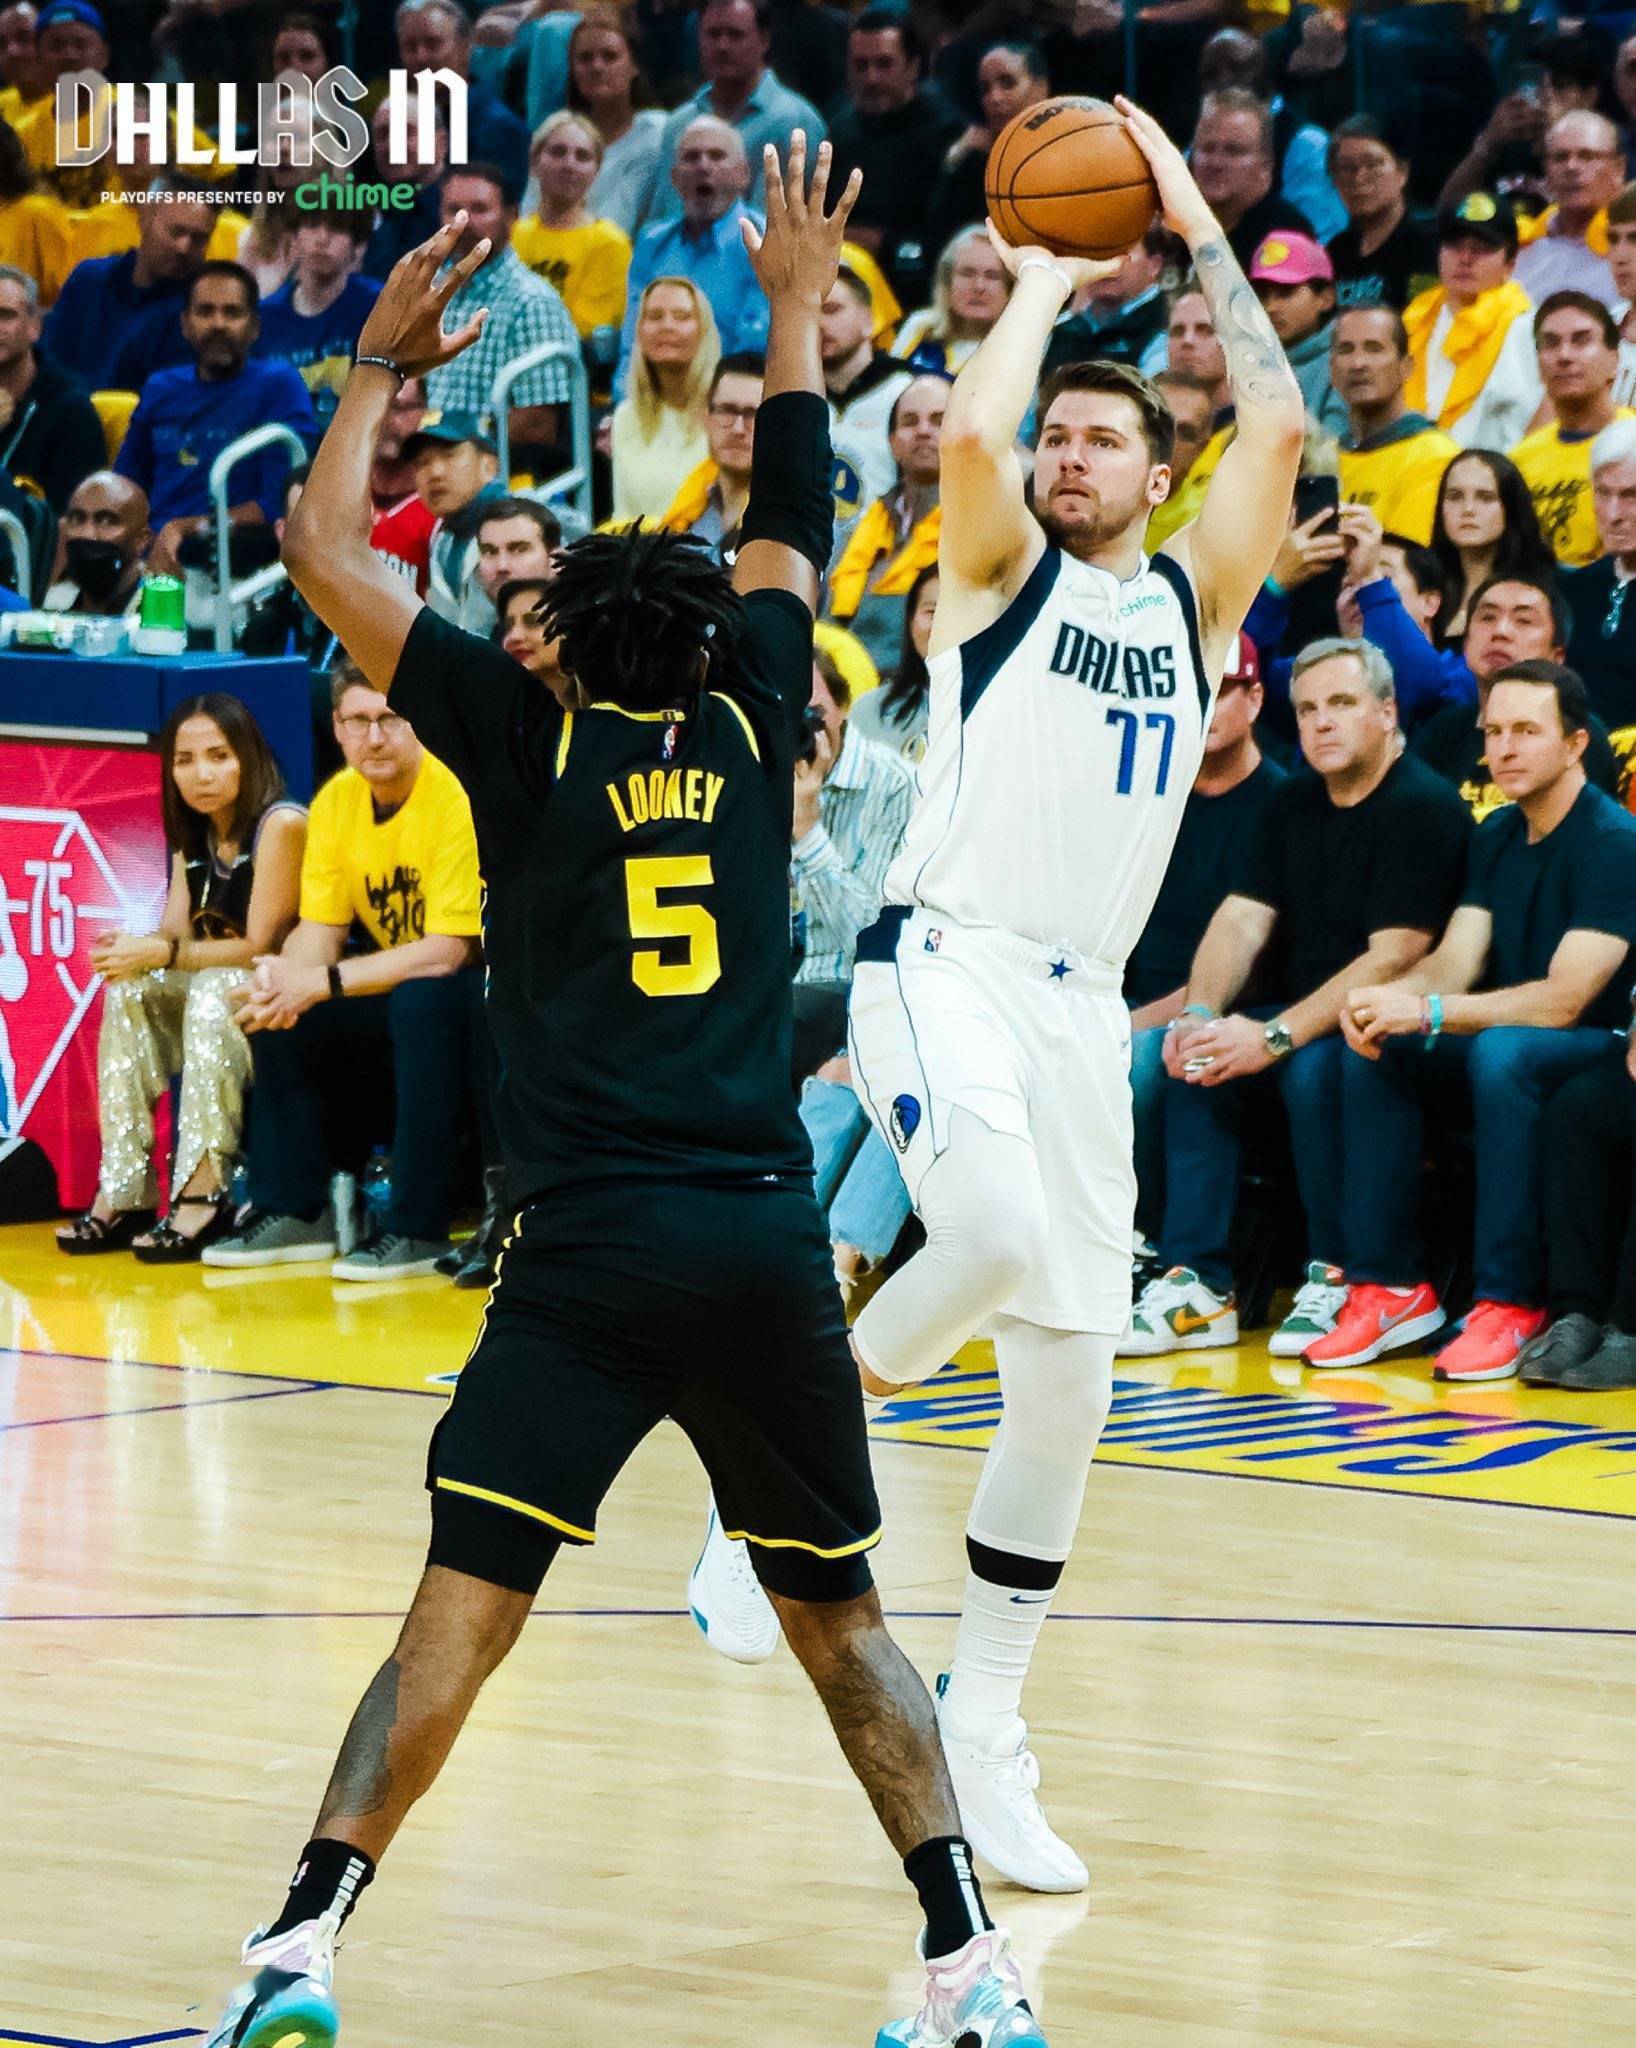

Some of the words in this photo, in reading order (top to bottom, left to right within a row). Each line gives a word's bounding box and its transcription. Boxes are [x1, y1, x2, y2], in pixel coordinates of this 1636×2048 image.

[1119, 594, 1168, 617] chime
[1049, 620, 1177, 700] DALAS
[1105, 708, 1176, 797] 77
[605, 768, 725, 833] LOONEY
[24, 859, 75, 958] 75
[625, 854, 722, 997] 5
